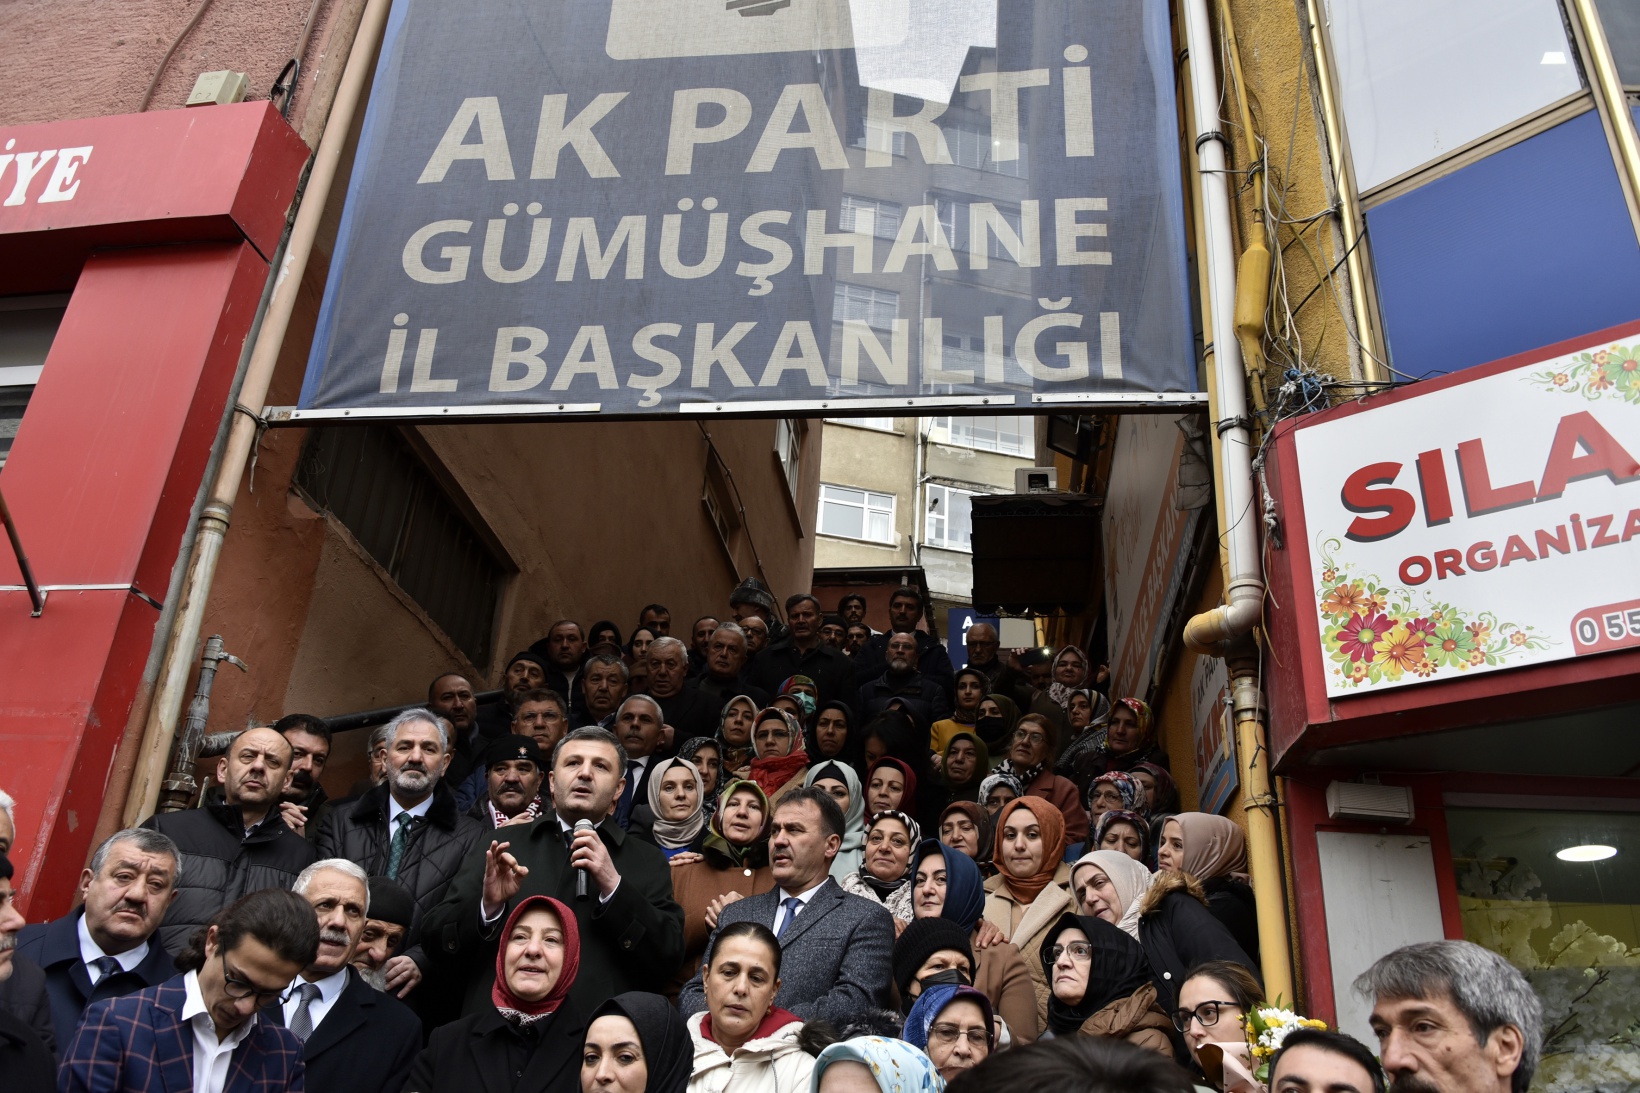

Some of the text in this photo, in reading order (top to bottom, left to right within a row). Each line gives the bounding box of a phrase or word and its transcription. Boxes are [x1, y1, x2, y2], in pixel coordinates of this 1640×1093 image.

[417, 44, 1095, 184] AK PARTİ
[402, 197, 1113, 296] GÜMÜŞHANE
[379, 296, 1124, 408] İL BAŞKANLIĞI
[1340, 410, 1640, 543] SILA
[1133, 594, 1149, 661] İLÇE
